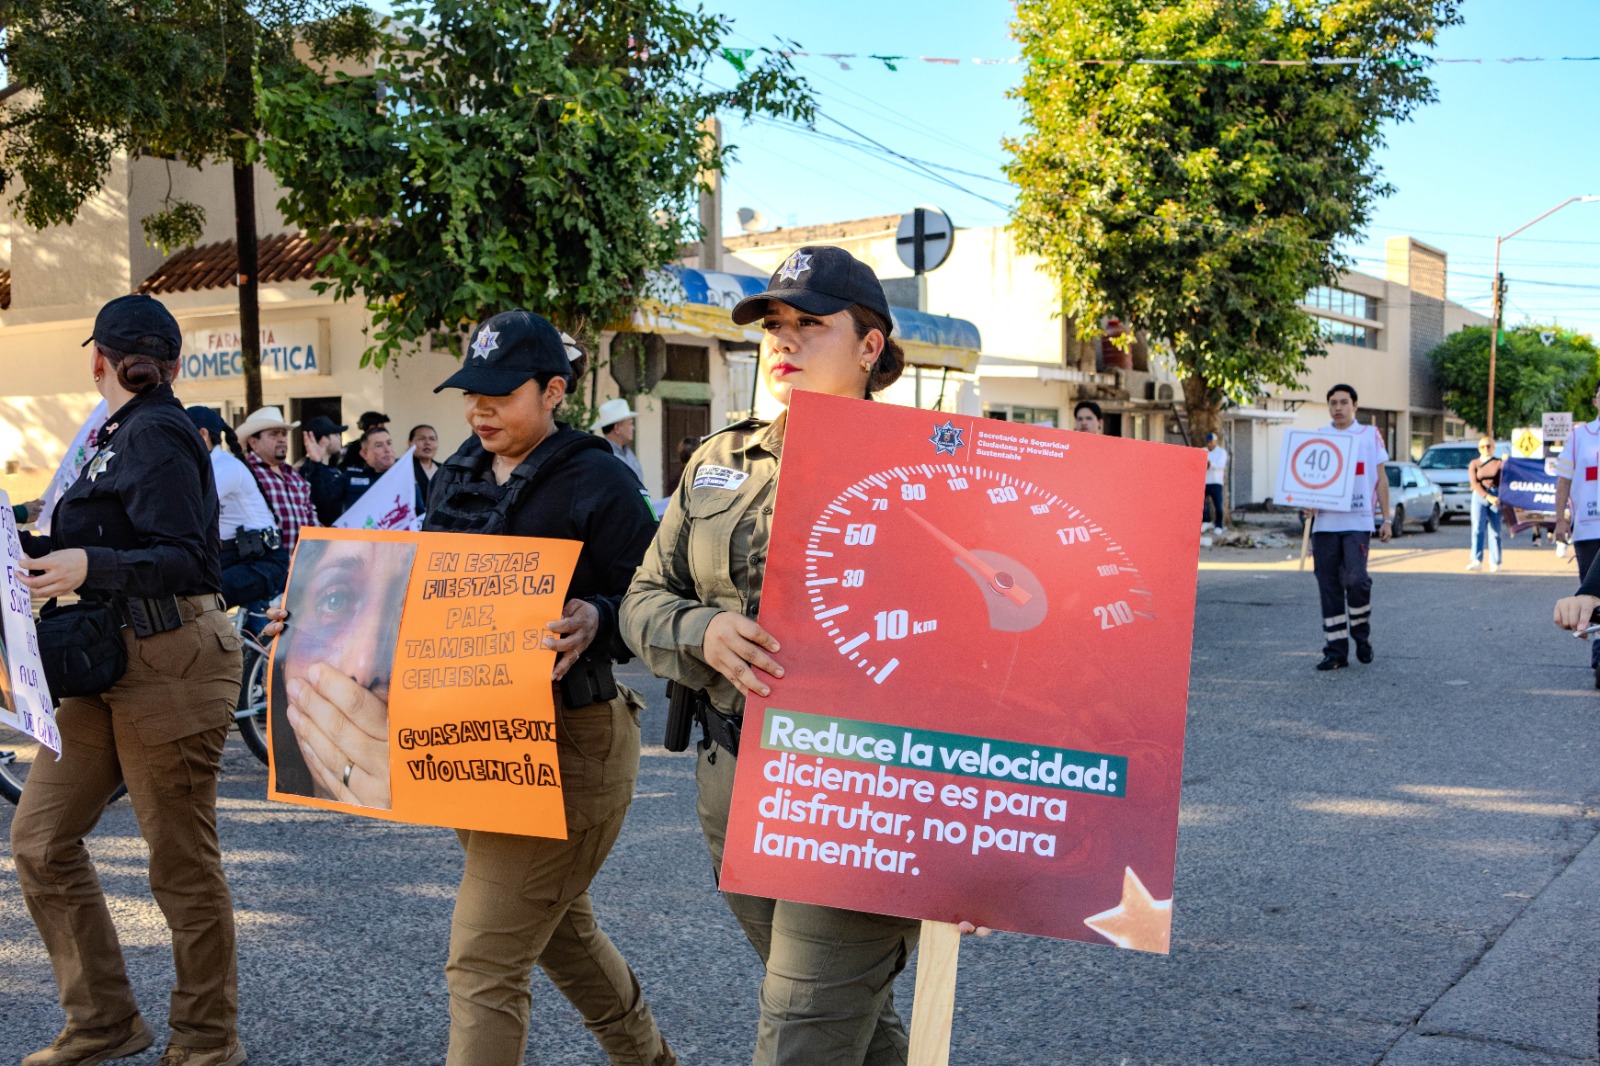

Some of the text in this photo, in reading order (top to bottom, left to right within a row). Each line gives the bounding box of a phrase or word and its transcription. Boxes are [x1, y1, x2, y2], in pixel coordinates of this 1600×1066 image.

[208, 330, 275, 349] FARMIA
[180, 344, 317, 378] HOMEOTICA
[976, 448, 1022, 461] Sustentable
[977, 440, 1018, 451] Ciudadana
[1026, 447, 1064, 458] Movilidad
[1030, 439, 1070, 450] Seguridad
[1304, 449, 1331, 472] 40
[901, 483, 926, 501] 90
[947, 477, 969, 491] 110
[872, 498, 888, 511] 70
[987, 486, 1019, 504] 130
[844, 524, 877, 546] 50
[1056, 526, 1091, 545] 170
[428, 552, 540, 574] EN ESTAS
[522, 574, 555, 595] LA
[842, 569, 865, 588] 30
[874, 609, 938, 641] 10 km
[1093, 600, 1135, 630] 210
[402, 663, 514, 690] CELEBRA.
[769, 715, 1118, 793] Reduce la velocidad:
[763, 752, 1068, 822] diciembre es para
[758, 787, 1057, 857] disfrutar, no para
[753, 821, 921, 876] lamentar.
